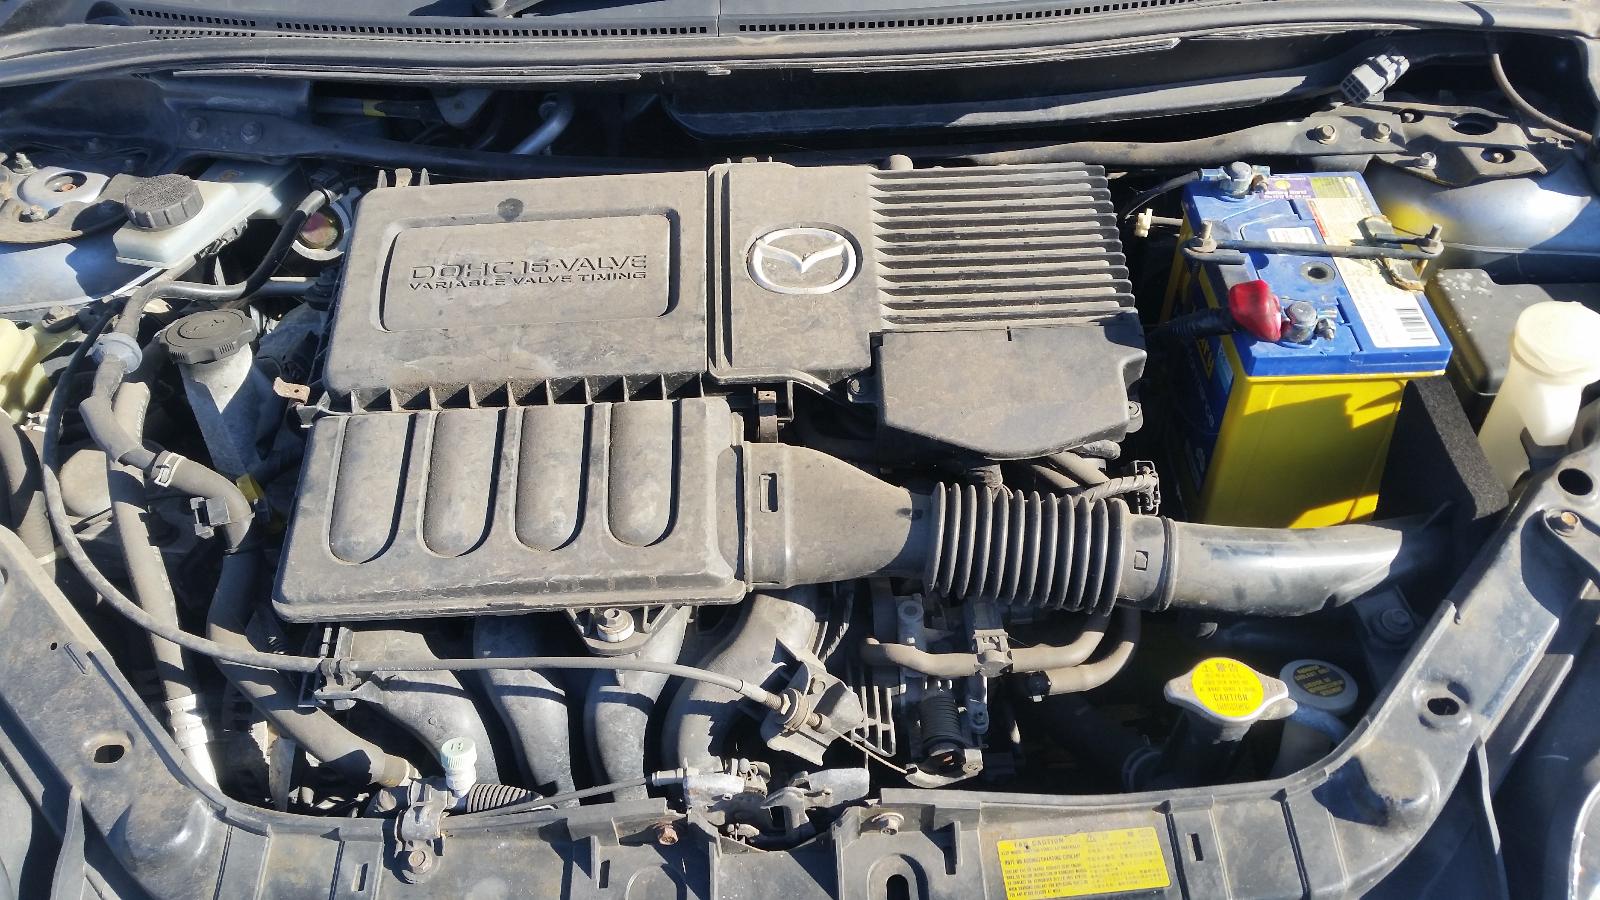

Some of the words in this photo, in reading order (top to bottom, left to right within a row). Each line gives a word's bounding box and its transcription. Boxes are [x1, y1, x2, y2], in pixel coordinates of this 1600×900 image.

[411, 261, 514, 279] DOHC
[409, 278, 506, 291] VARIABLE
[513, 274, 573, 286] VALVE
[578, 271, 647, 282] TIMING
[1213, 693, 1248, 702] CAUTION
